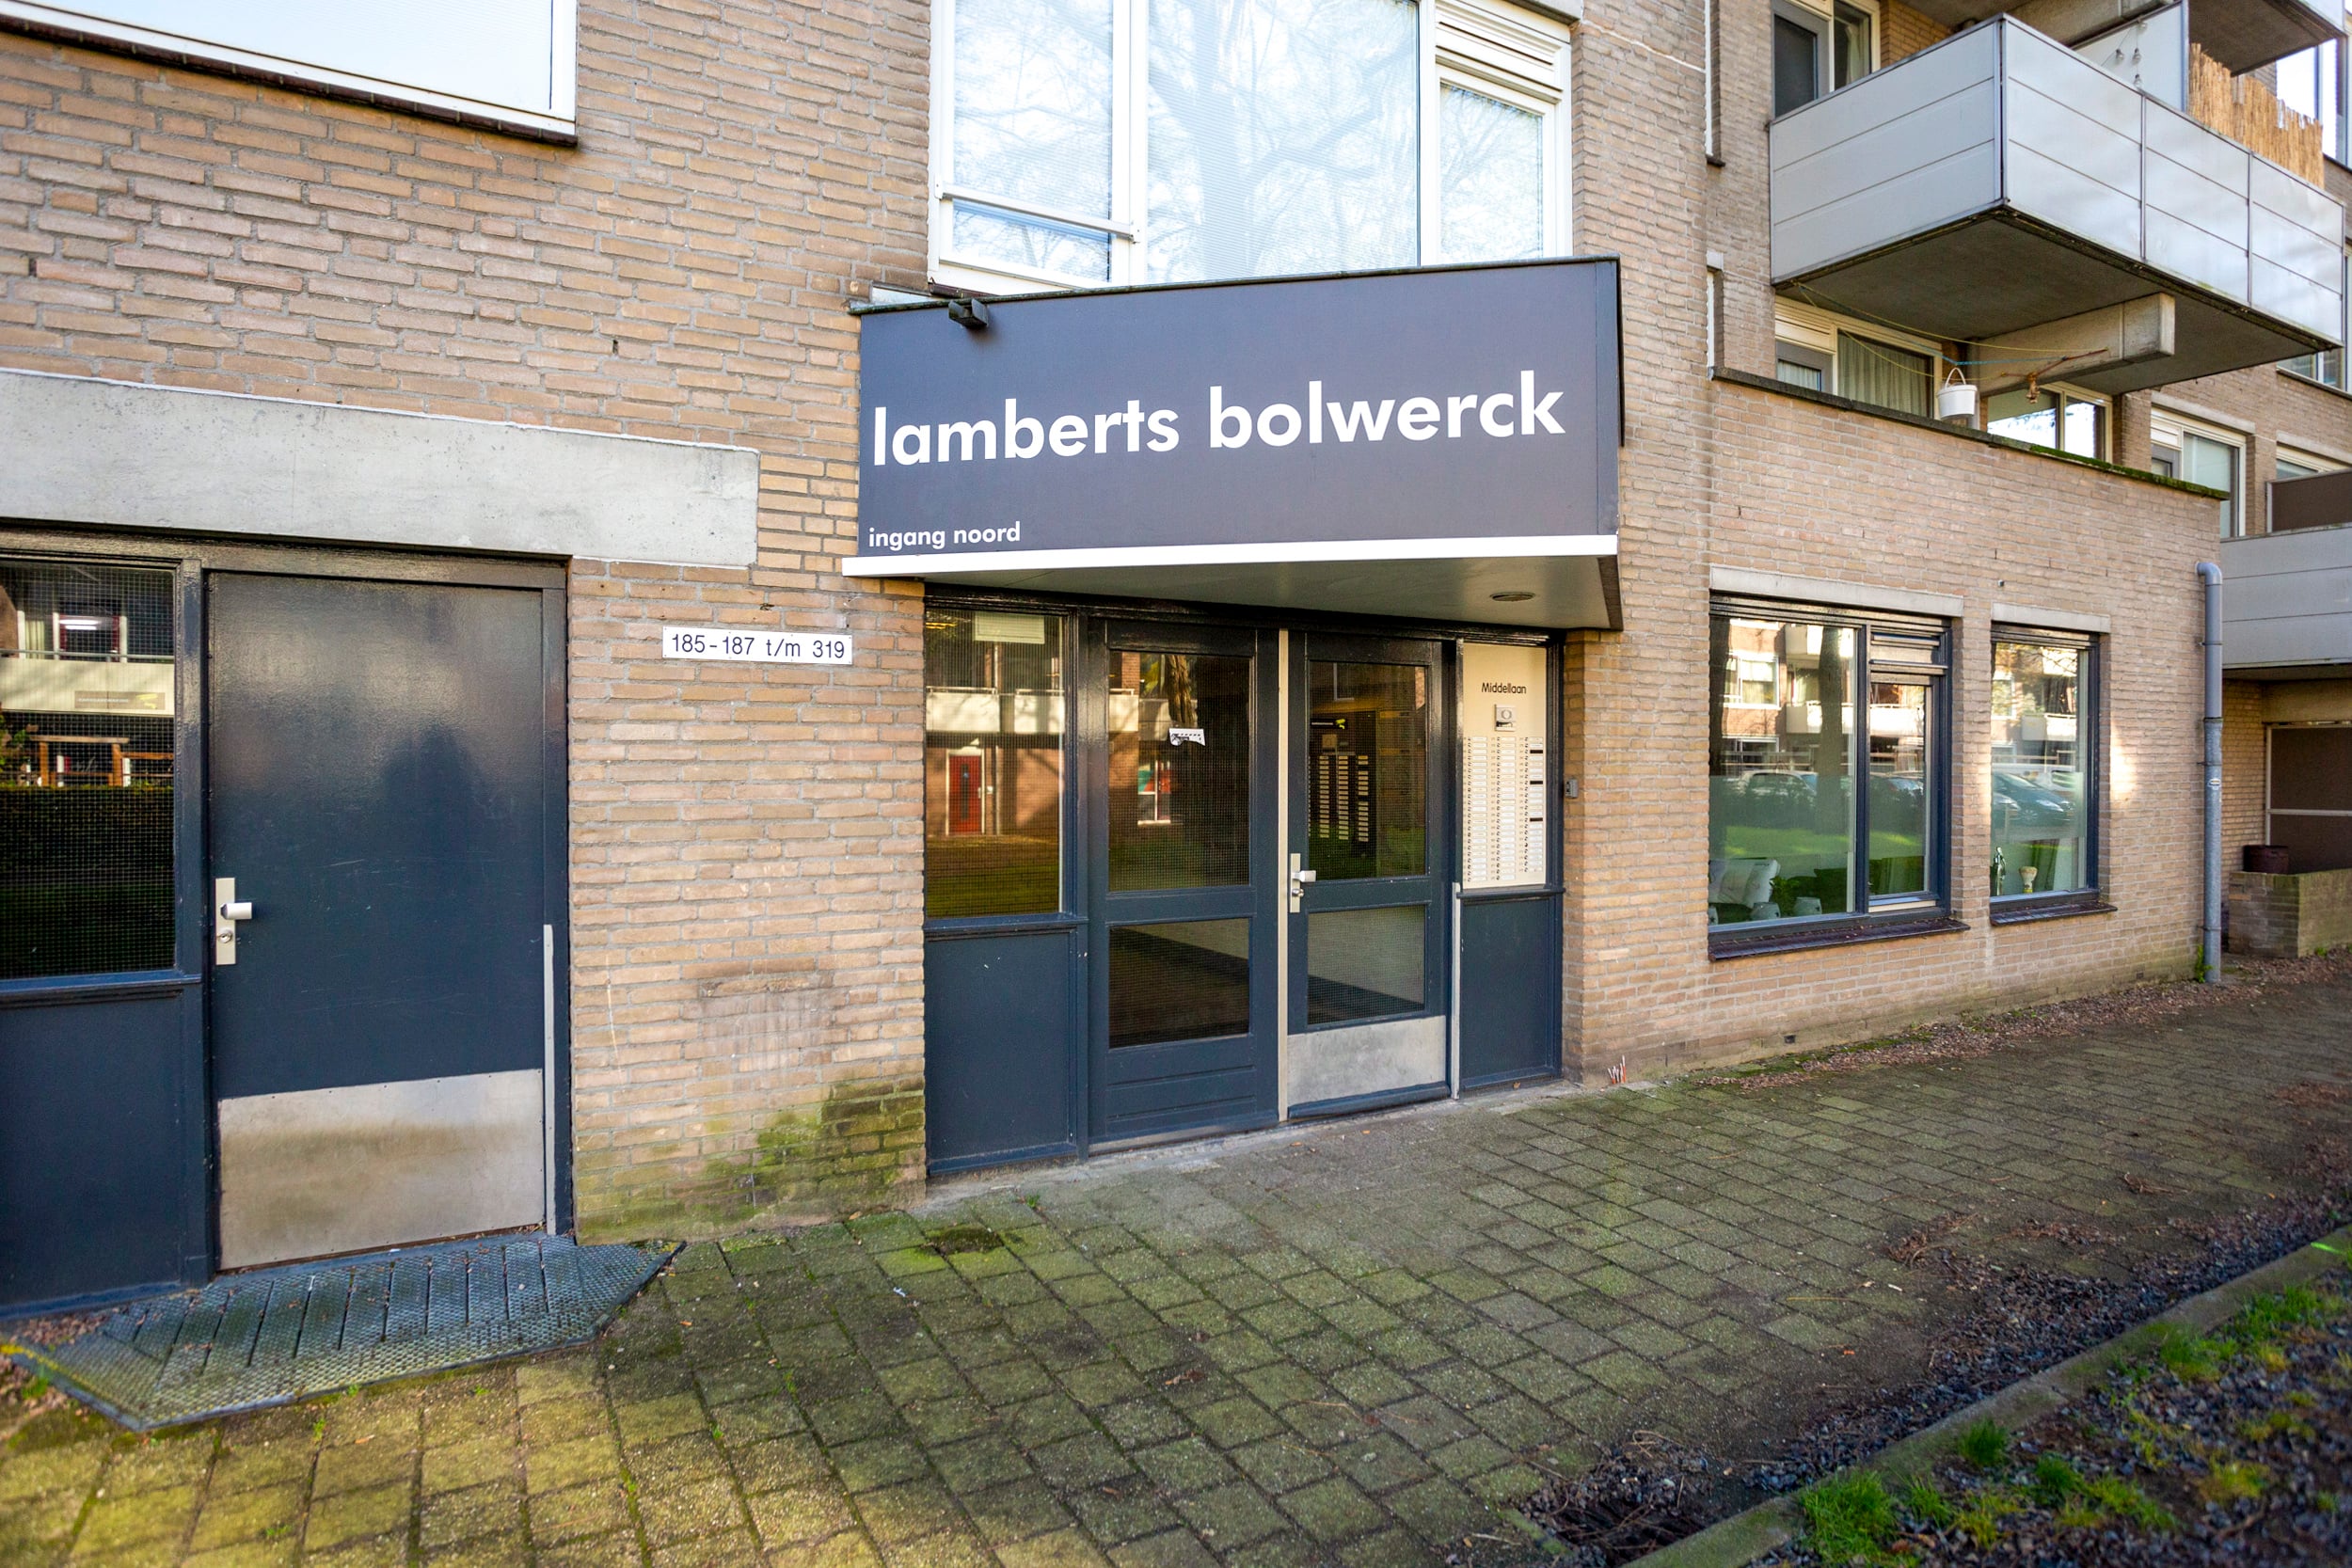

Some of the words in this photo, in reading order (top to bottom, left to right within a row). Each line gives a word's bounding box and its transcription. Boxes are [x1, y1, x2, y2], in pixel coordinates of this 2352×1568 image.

[874, 398, 1180, 467] lamberts
[1209, 370, 1566, 449] bolwerck
[868, 527, 946, 551] ingang
[953, 520, 1021, 544] noord
[765, 638, 801, 657] t/m
[812, 640, 845, 659] 319
[1481, 681, 1527, 695] Middellaan
